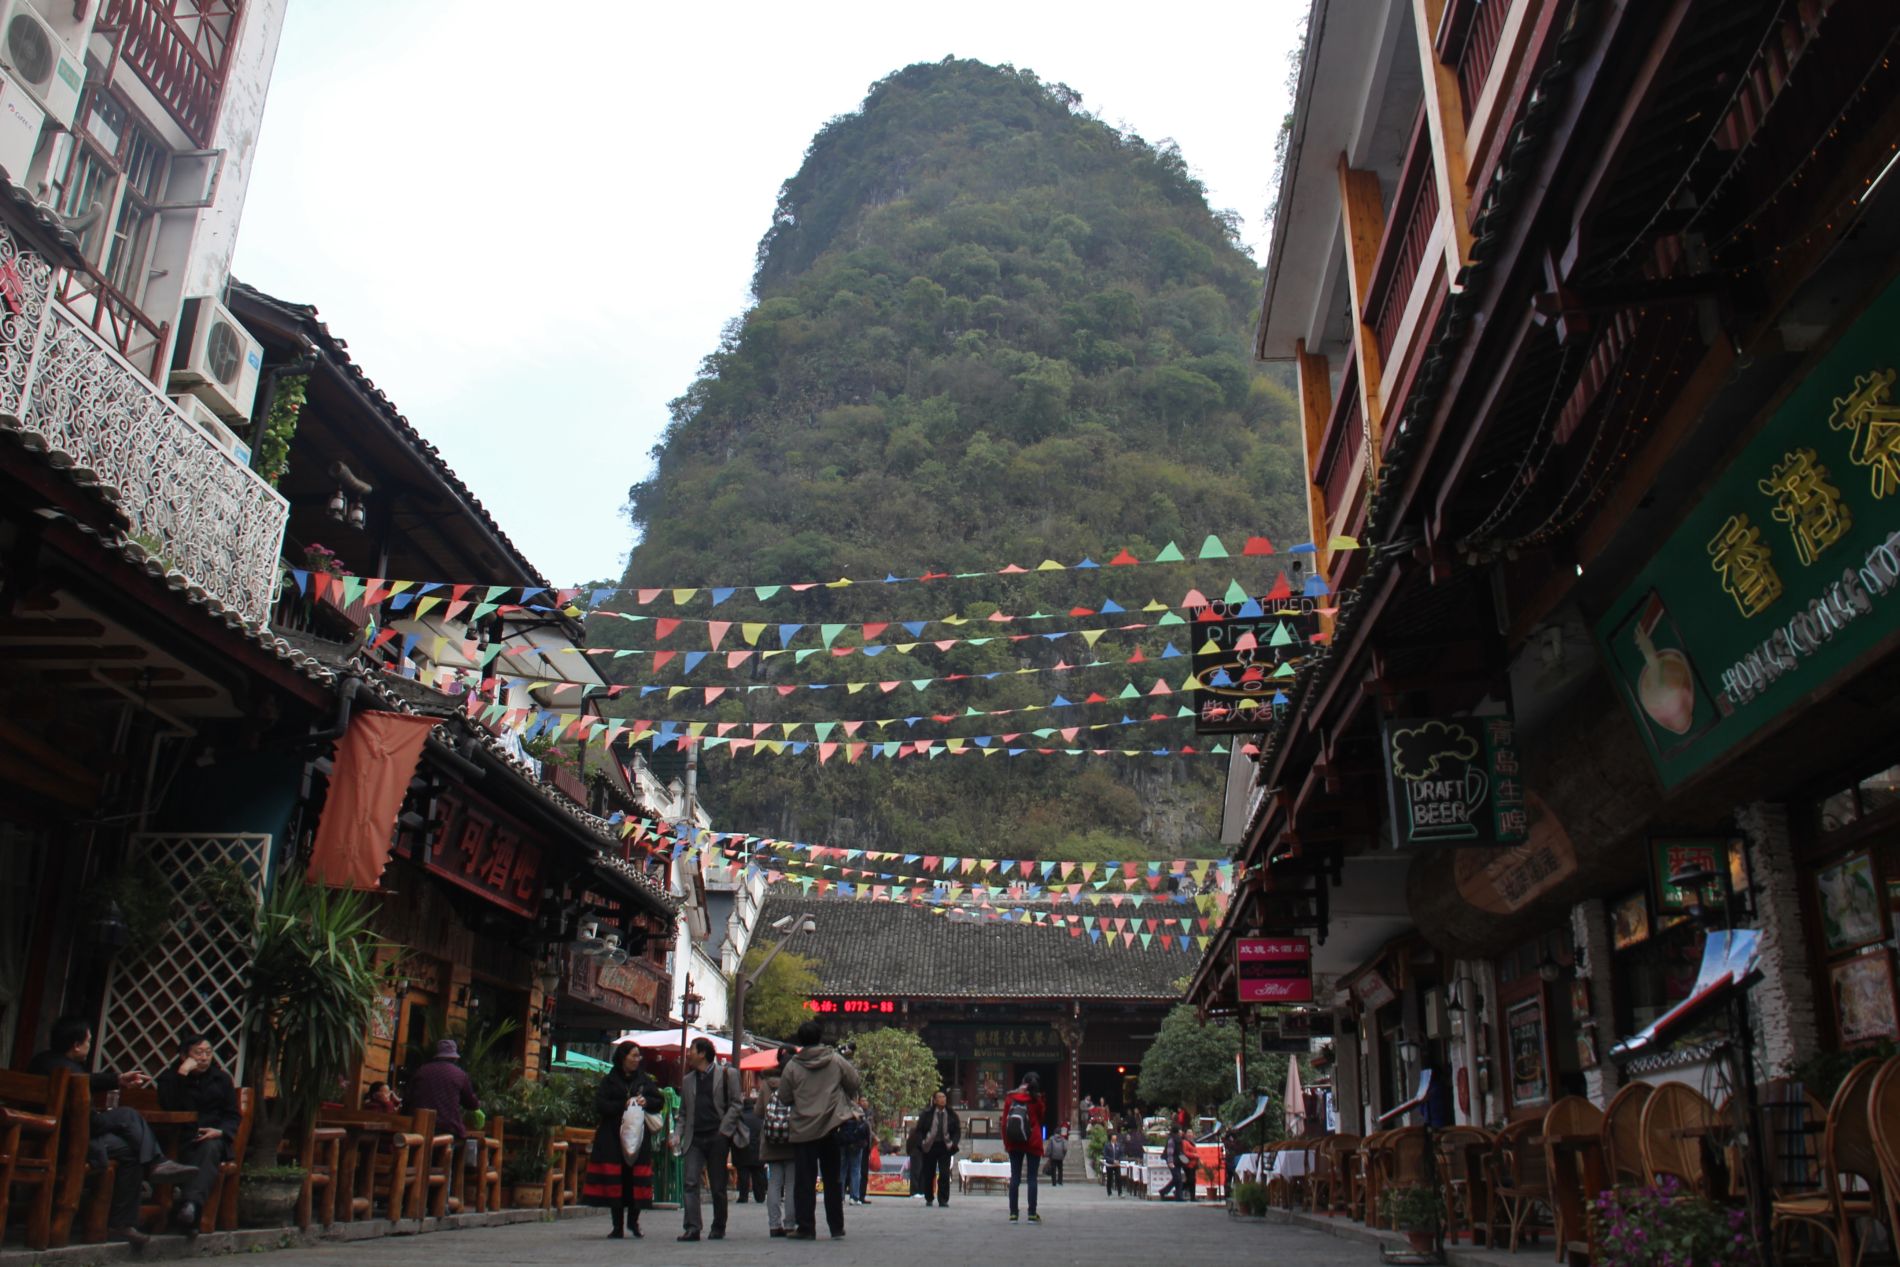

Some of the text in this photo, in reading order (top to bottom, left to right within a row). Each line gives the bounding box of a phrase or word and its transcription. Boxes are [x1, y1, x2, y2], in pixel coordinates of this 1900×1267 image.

[1193, 597, 1314, 617] WOO FIRED
[1412, 779, 1464, 802] DRAFT
[1413, 801, 1468, 825] BEER
[1254, 982, 1296, 996] Hotel
[844, 1001, 894, 1013] 0773-88
